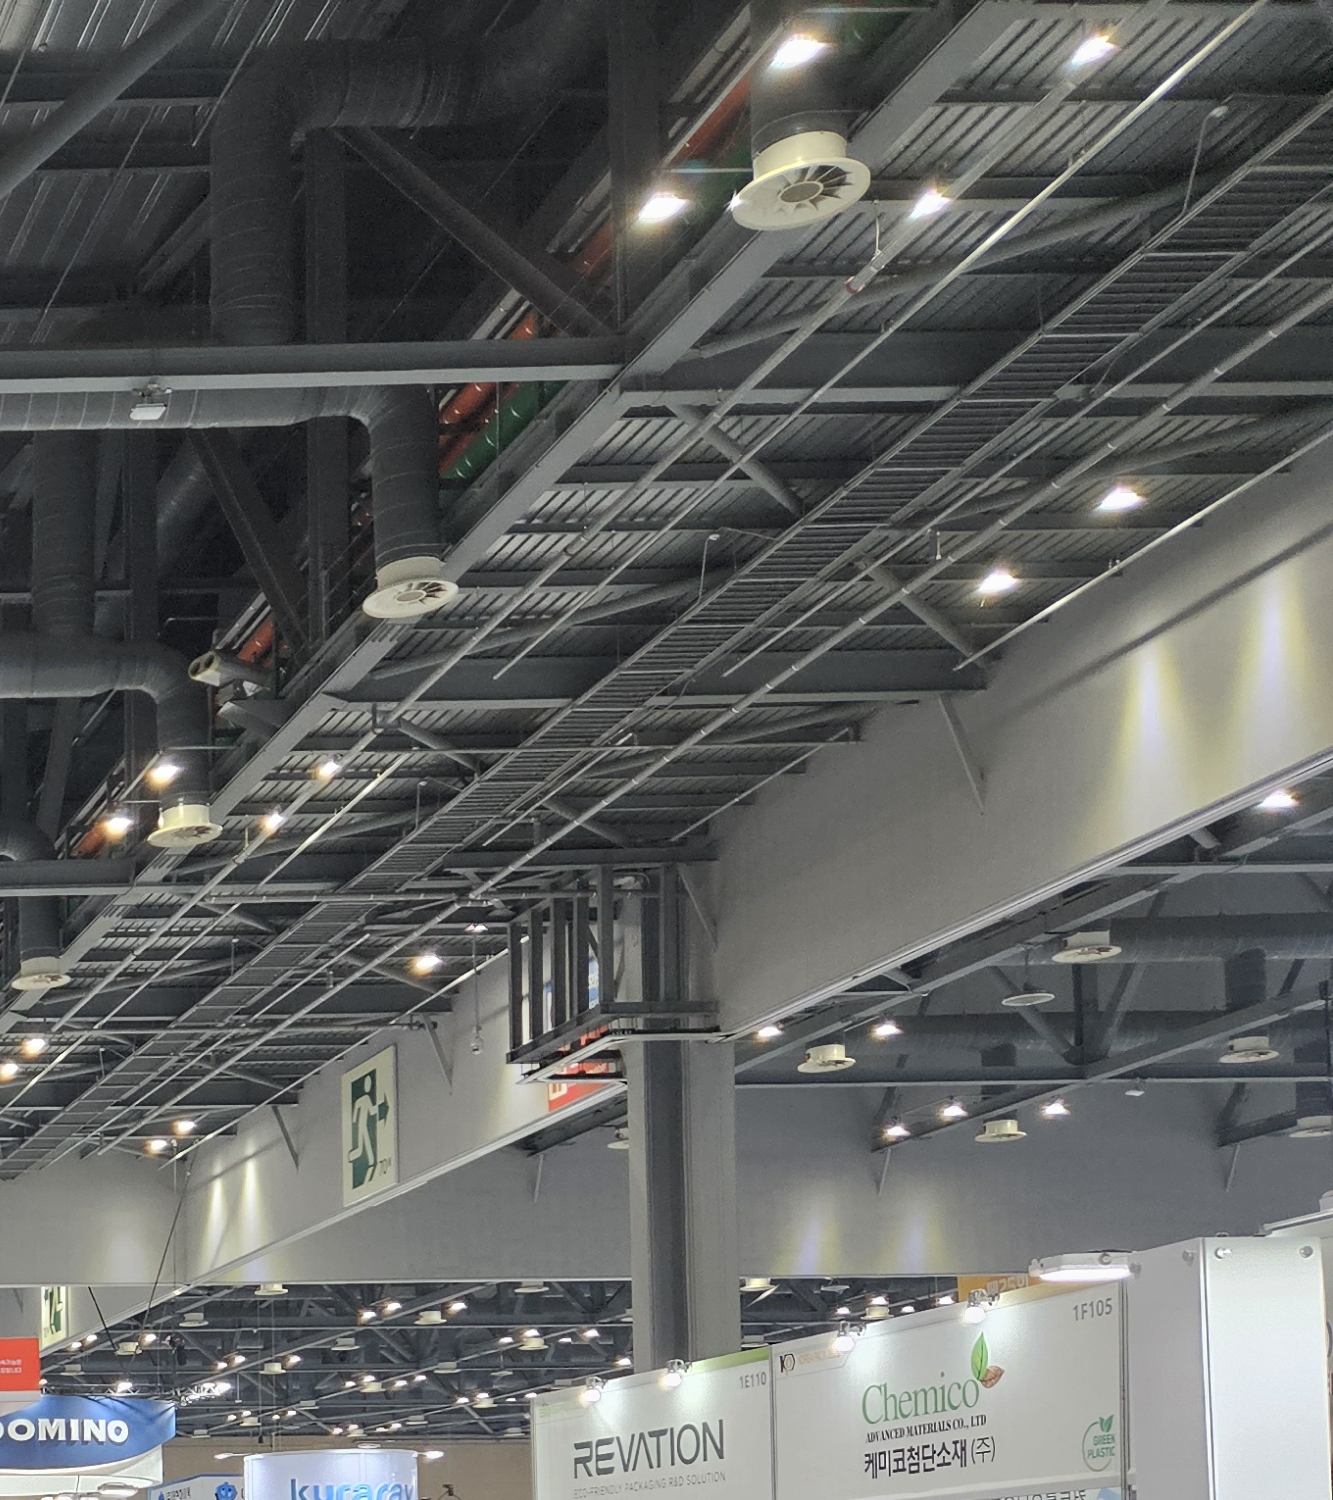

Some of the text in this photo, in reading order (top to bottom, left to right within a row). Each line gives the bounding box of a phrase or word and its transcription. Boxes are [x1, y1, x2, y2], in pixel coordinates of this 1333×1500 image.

[1072, 1297, 1113, 1322] 1F105
[739, 1371, 767, 1389] 1E110
[861, 1371, 980, 1425] Chemico
[866, 1427, 905, 1444] ADVANCED
[907, 1420, 952, 1438] MATERIALS
[970, 1414, 987, 1427] LTD
[573, 1419, 725, 1480] REVATION
[864, 1435, 996, 1480] 케미코첨단소재 (주)
[1086, 1446, 1116, 1459] PLASTIC
[624, 1477, 667, 1493] PACKAGING
[668, 1475, 684, 1488] R&D
[686, 1471, 726, 1487] SOLUTION
